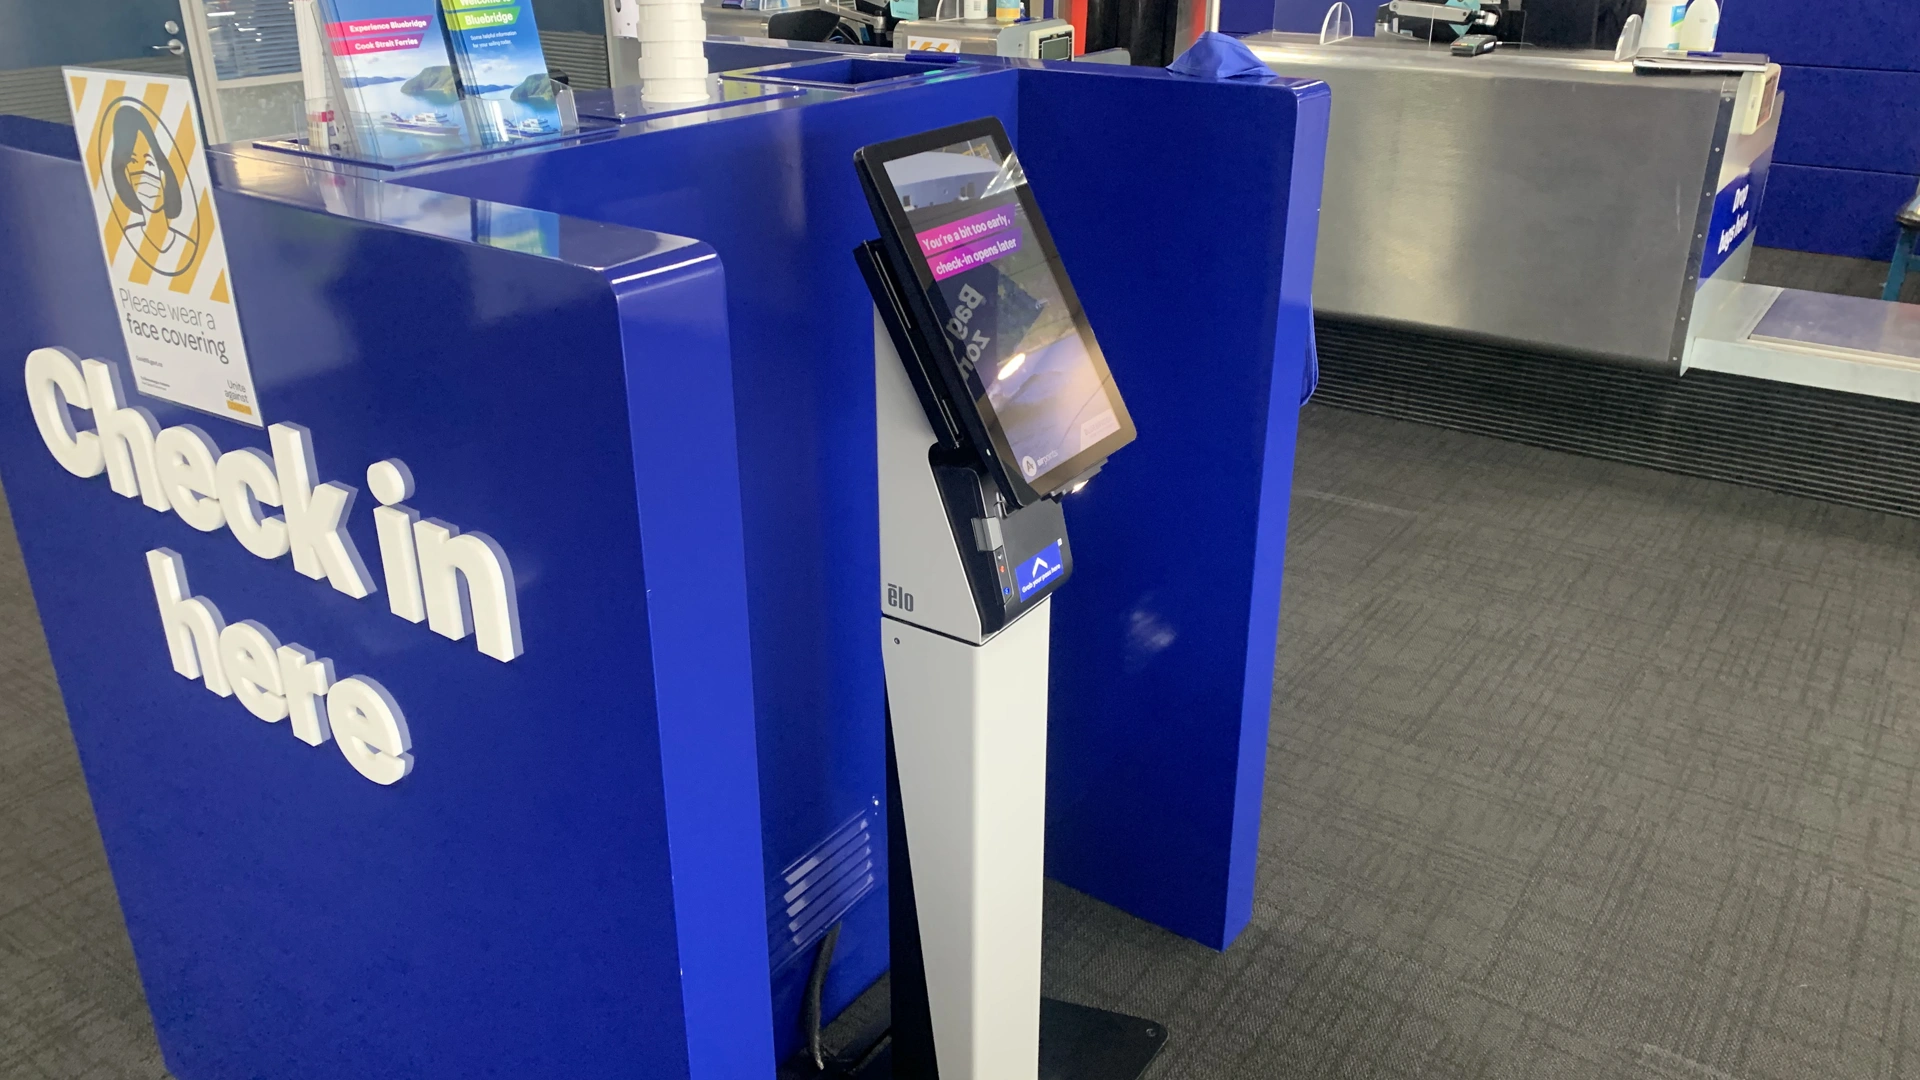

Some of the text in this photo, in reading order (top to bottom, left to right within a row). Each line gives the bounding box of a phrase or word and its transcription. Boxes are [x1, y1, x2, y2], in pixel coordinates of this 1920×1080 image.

[349, 19, 427, 33] Experience Bluebridge
[464, 11, 514, 26] Bluebridge
[355, 38, 418, 50] Cook Strait Ferries
[1732, 184, 1749, 213] Drop
[922, 213, 1011, 251] You're a bit too early,
[1718, 210, 1749, 255] bags here
[936, 238, 1017, 275] check-in opens later
[119, 287, 217, 331] Please wear a
[126, 312, 230, 365] face covering
[224, 390, 249, 404] against
[226, 379, 247, 393] Unite
[25, 346, 524, 663] Check in
[1021, 563, 1061, 593] Grab your pass here
[146, 547, 414, 785] here
